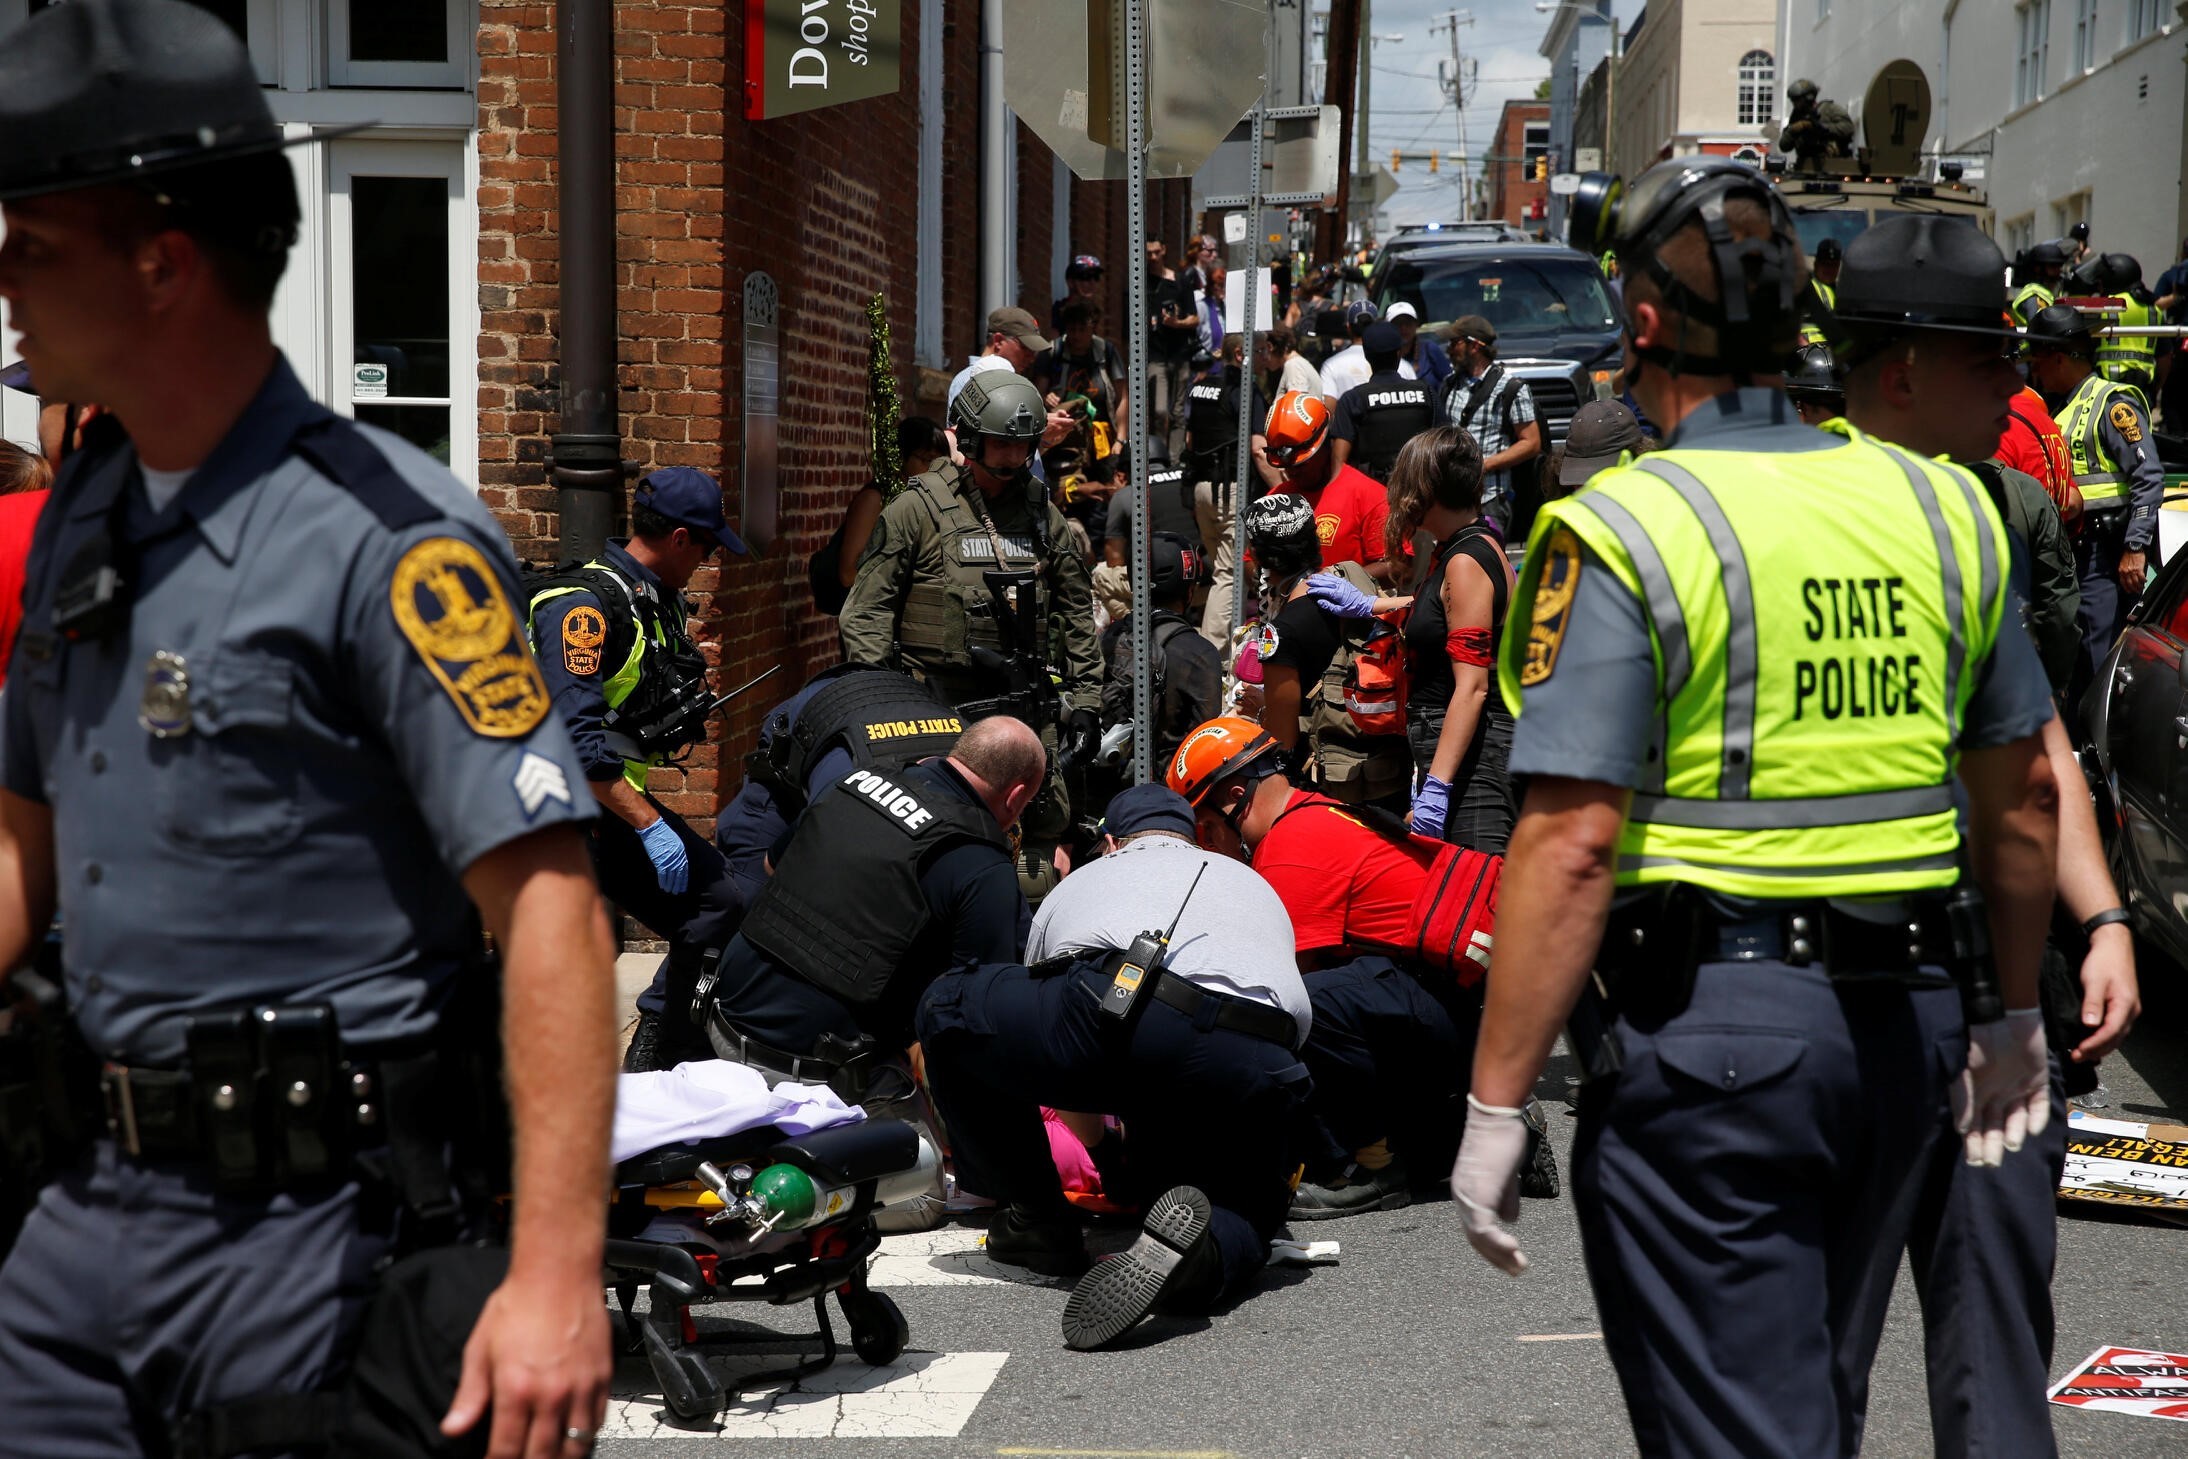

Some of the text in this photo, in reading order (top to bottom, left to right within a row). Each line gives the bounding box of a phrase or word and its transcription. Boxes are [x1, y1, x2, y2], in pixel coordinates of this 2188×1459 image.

[1189, 385, 1221, 400] POLICE
[1368, 390, 1425, 407] POLICE
[1148, 470, 1183, 485] POLIC
[1803, 578, 1906, 642] STATE
[566, 647, 599, 660] VIRGINIA
[570, 656, 594, 664] STATE
[568, 662, 596, 673] POLICE
[1793, 655, 1920, 721] POLICE
[865, 718, 962, 740] STATE POLICE
[843, 769, 934, 831] POLICE
[2068, 1142, 2145, 1160] BEIN
